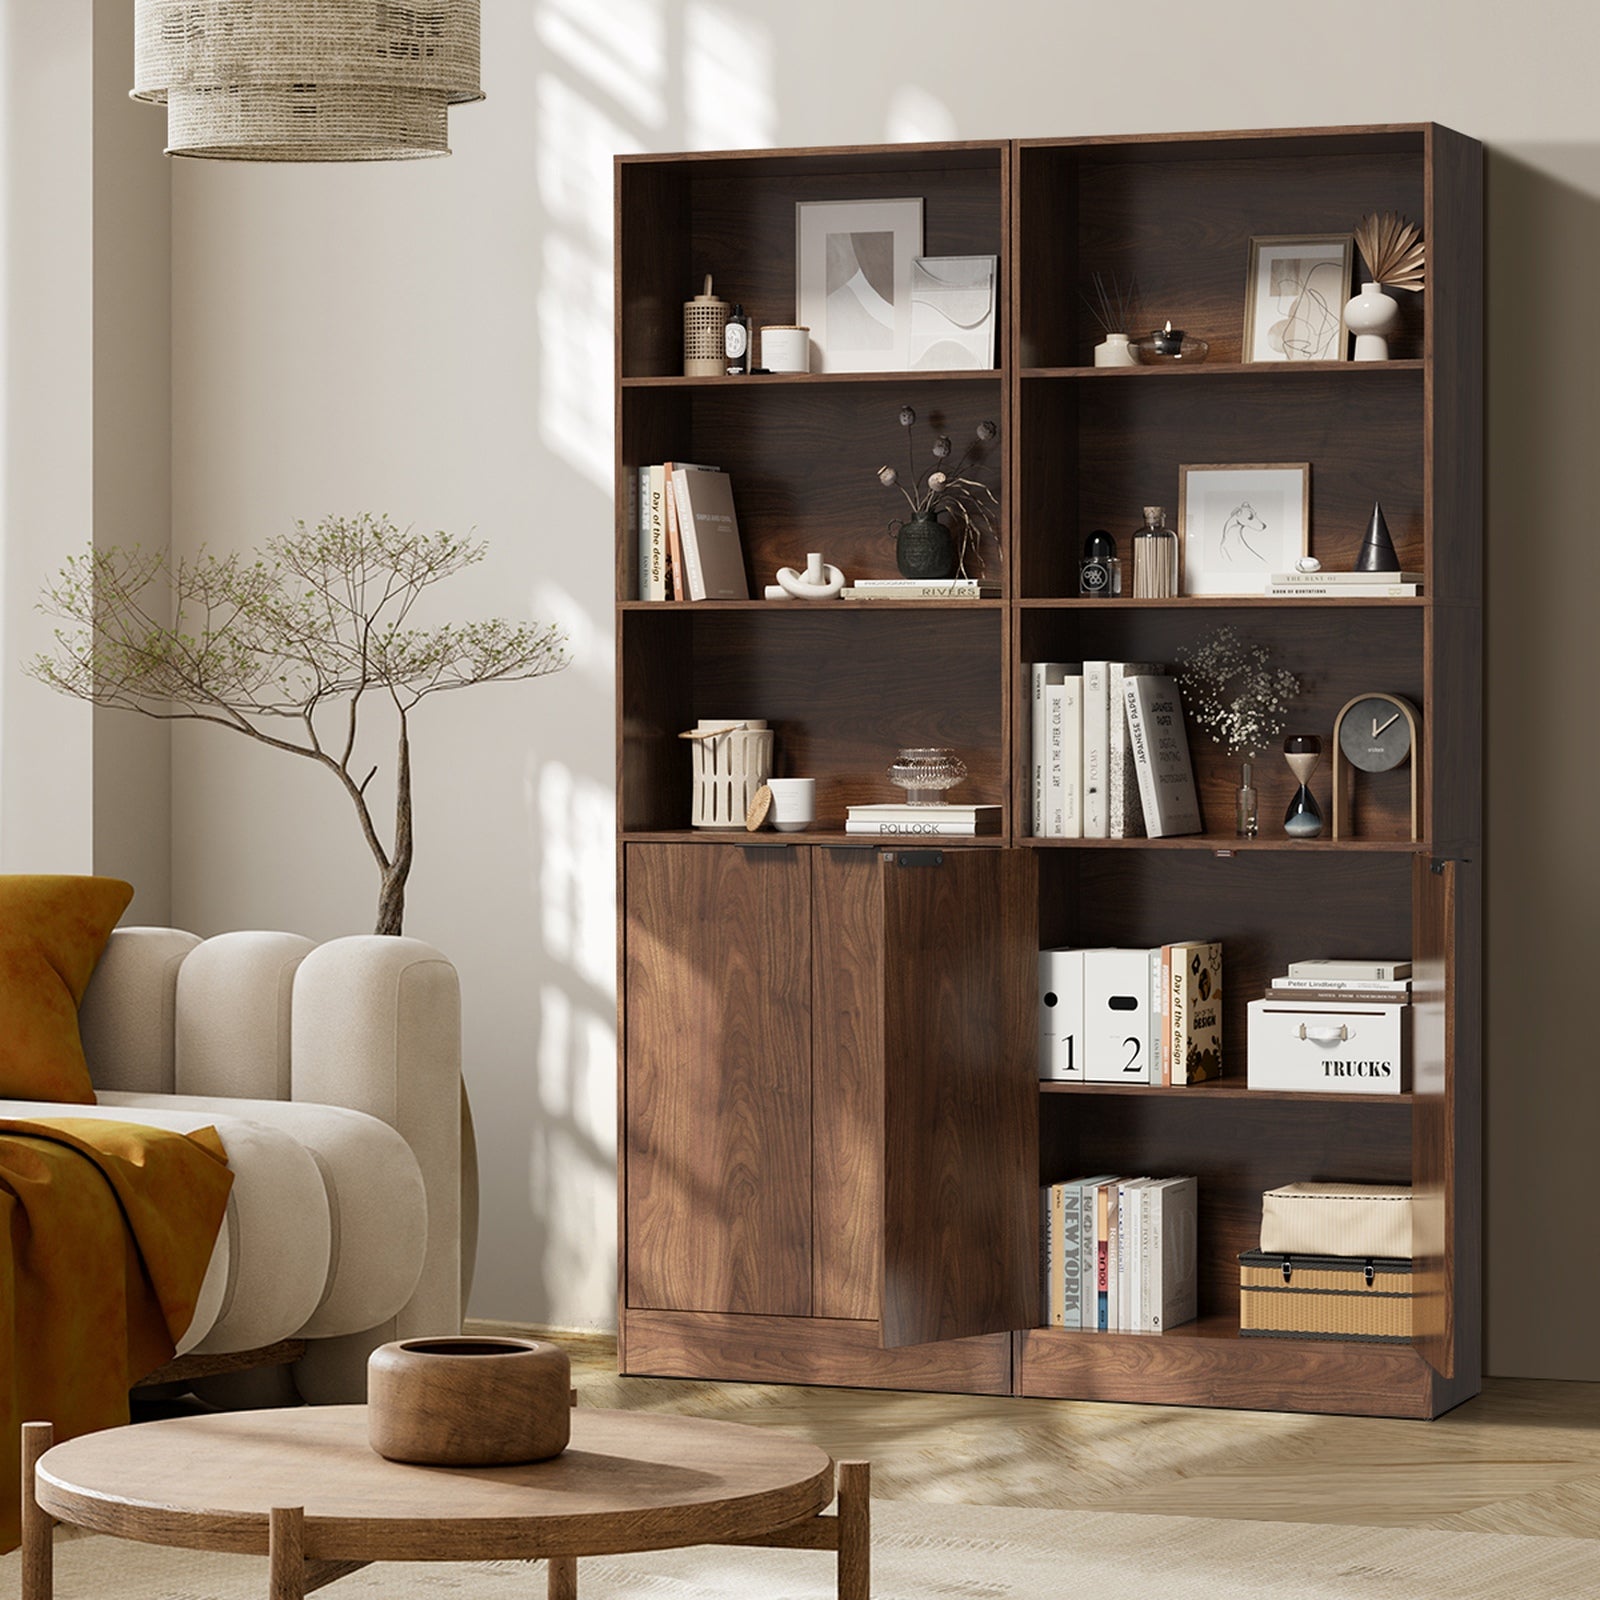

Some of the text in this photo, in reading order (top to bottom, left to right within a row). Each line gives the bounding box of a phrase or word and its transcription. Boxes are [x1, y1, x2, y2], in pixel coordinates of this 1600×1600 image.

[652, 492, 661, 582] Day of the design
[922, 588, 976, 596] RIVERS
[1053, 698, 1061, 787] ART IN THE AFTER CULTURE
[1127, 691, 1147, 764] JAPANESE PAPER
[1090, 749, 1098, 781] POEMS
[879, 823, 940, 834] POLLOCK
[1308, 980, 1347, 989] Lindbergh
[1173, 975, 1182, 1065] Day of the design
[1193, 1016, 1216, 1030] DESIGN
[1061, 1034, 1079, 1071] 1
[1122, 1036, 1143, 1073] 2
[1321, 1060, 1391, 1077] TRUCKS
[1064, 1196, 1080, 1245] NEW
[1064, 1247, 1080, 1311] YORK
